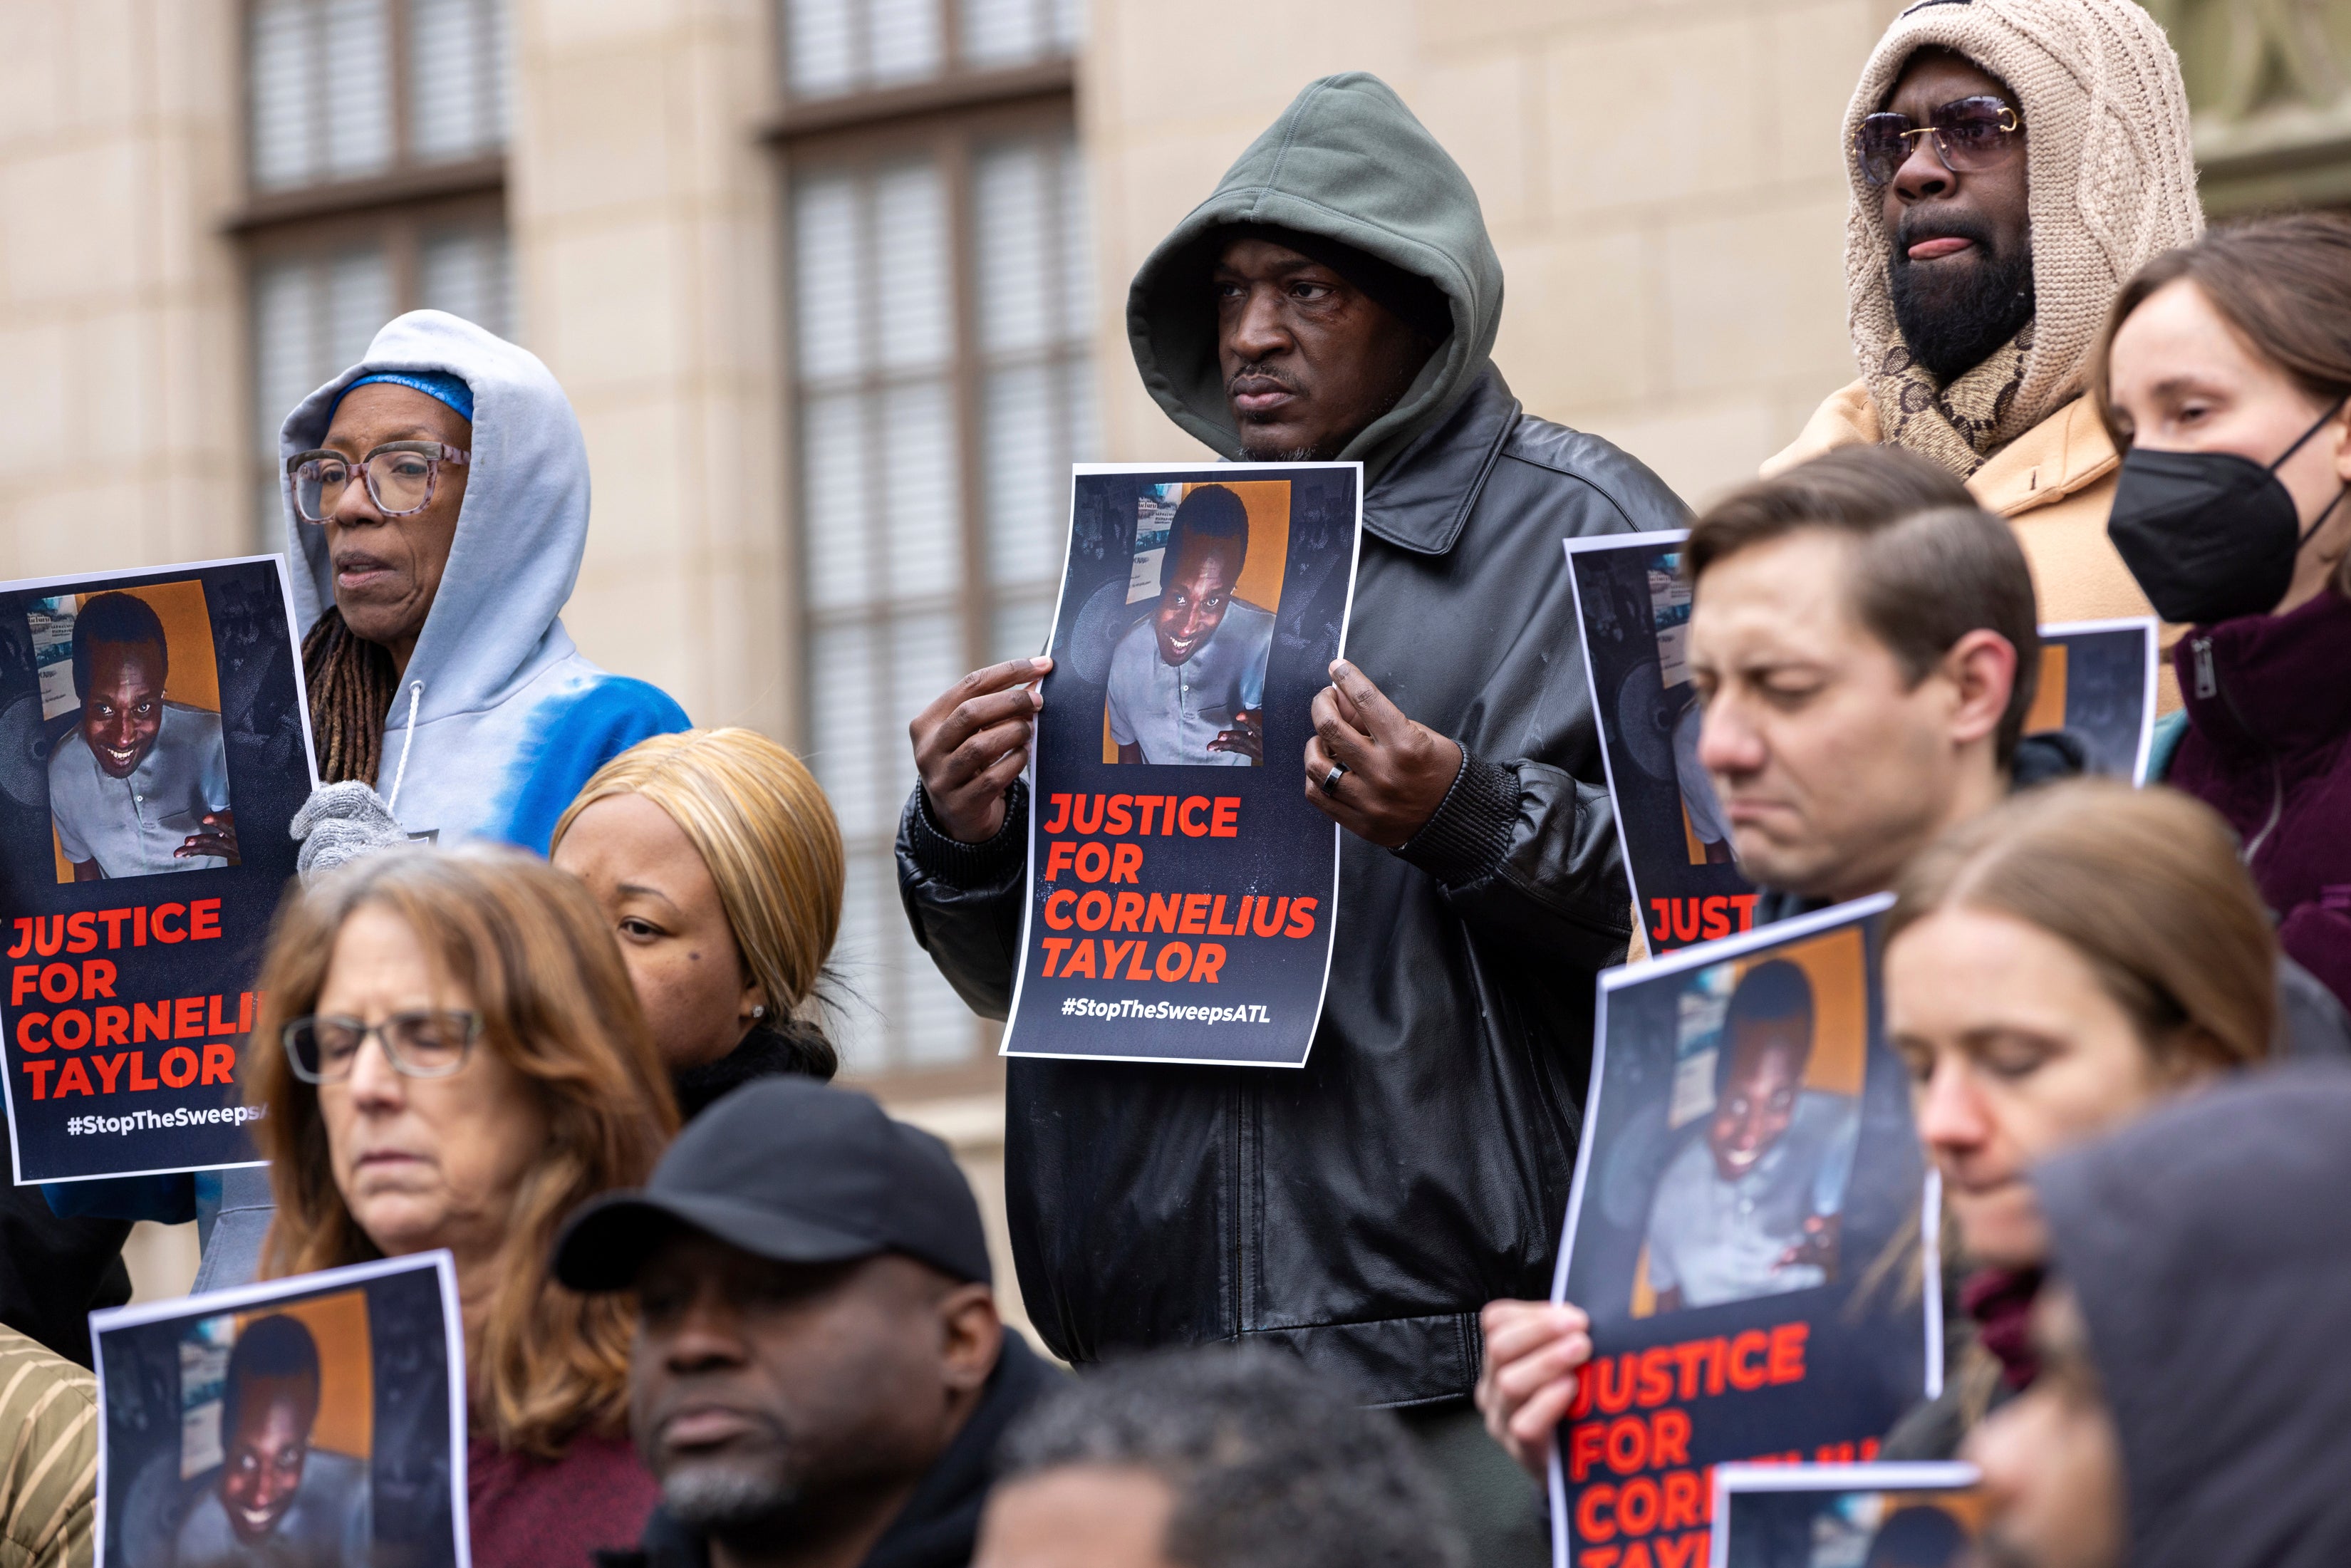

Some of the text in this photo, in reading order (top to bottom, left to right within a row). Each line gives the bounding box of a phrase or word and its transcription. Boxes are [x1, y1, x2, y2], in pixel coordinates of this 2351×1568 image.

[1044, 793, 1242, 838] JUSTICE
[1044, 841, 1144, 884] FOR
[6, 898, 222, 959] JUSTICE
[1044, 888, 1319, 940] CORNELIUS
[11, 959, 118, 1006] FOR
[1042, 938, 1227, 984] TAYLOR
[1061, 997, 1271, 1024] #StopTheSweepsATL
[23, 1043, 237, 1101] TAYLOR
[1571, 1408, 1692, 1482] FOR
